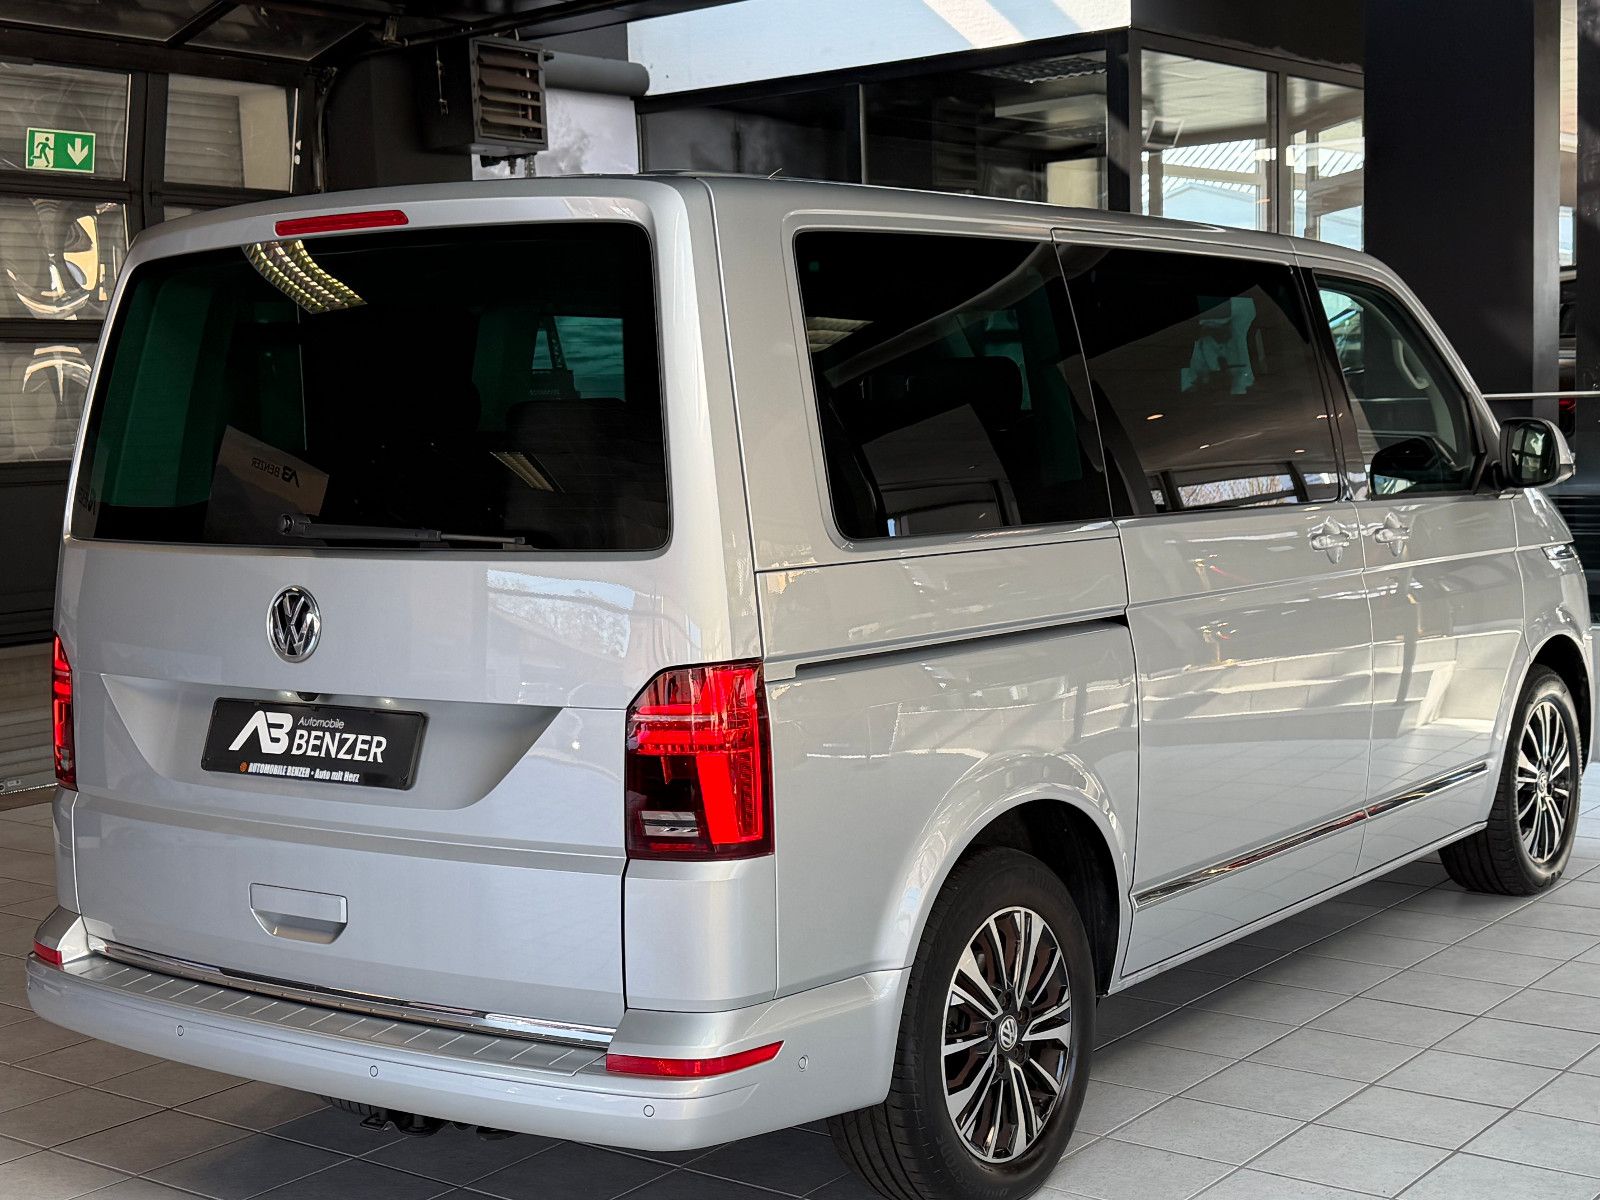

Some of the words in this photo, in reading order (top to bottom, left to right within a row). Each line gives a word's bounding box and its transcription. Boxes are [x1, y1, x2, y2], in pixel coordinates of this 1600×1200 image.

[298, 716, 345, 730] Automobile
[291, 729, 387, 763] BENZER
[248, 762, 288, 776] AUTOMOBILE
[286, 766, 311, 778] BENZER
[314, 768, 331, 780] Auto
[330, 771, 343, 781] mit
[343, 771, 360, 783] Herz
